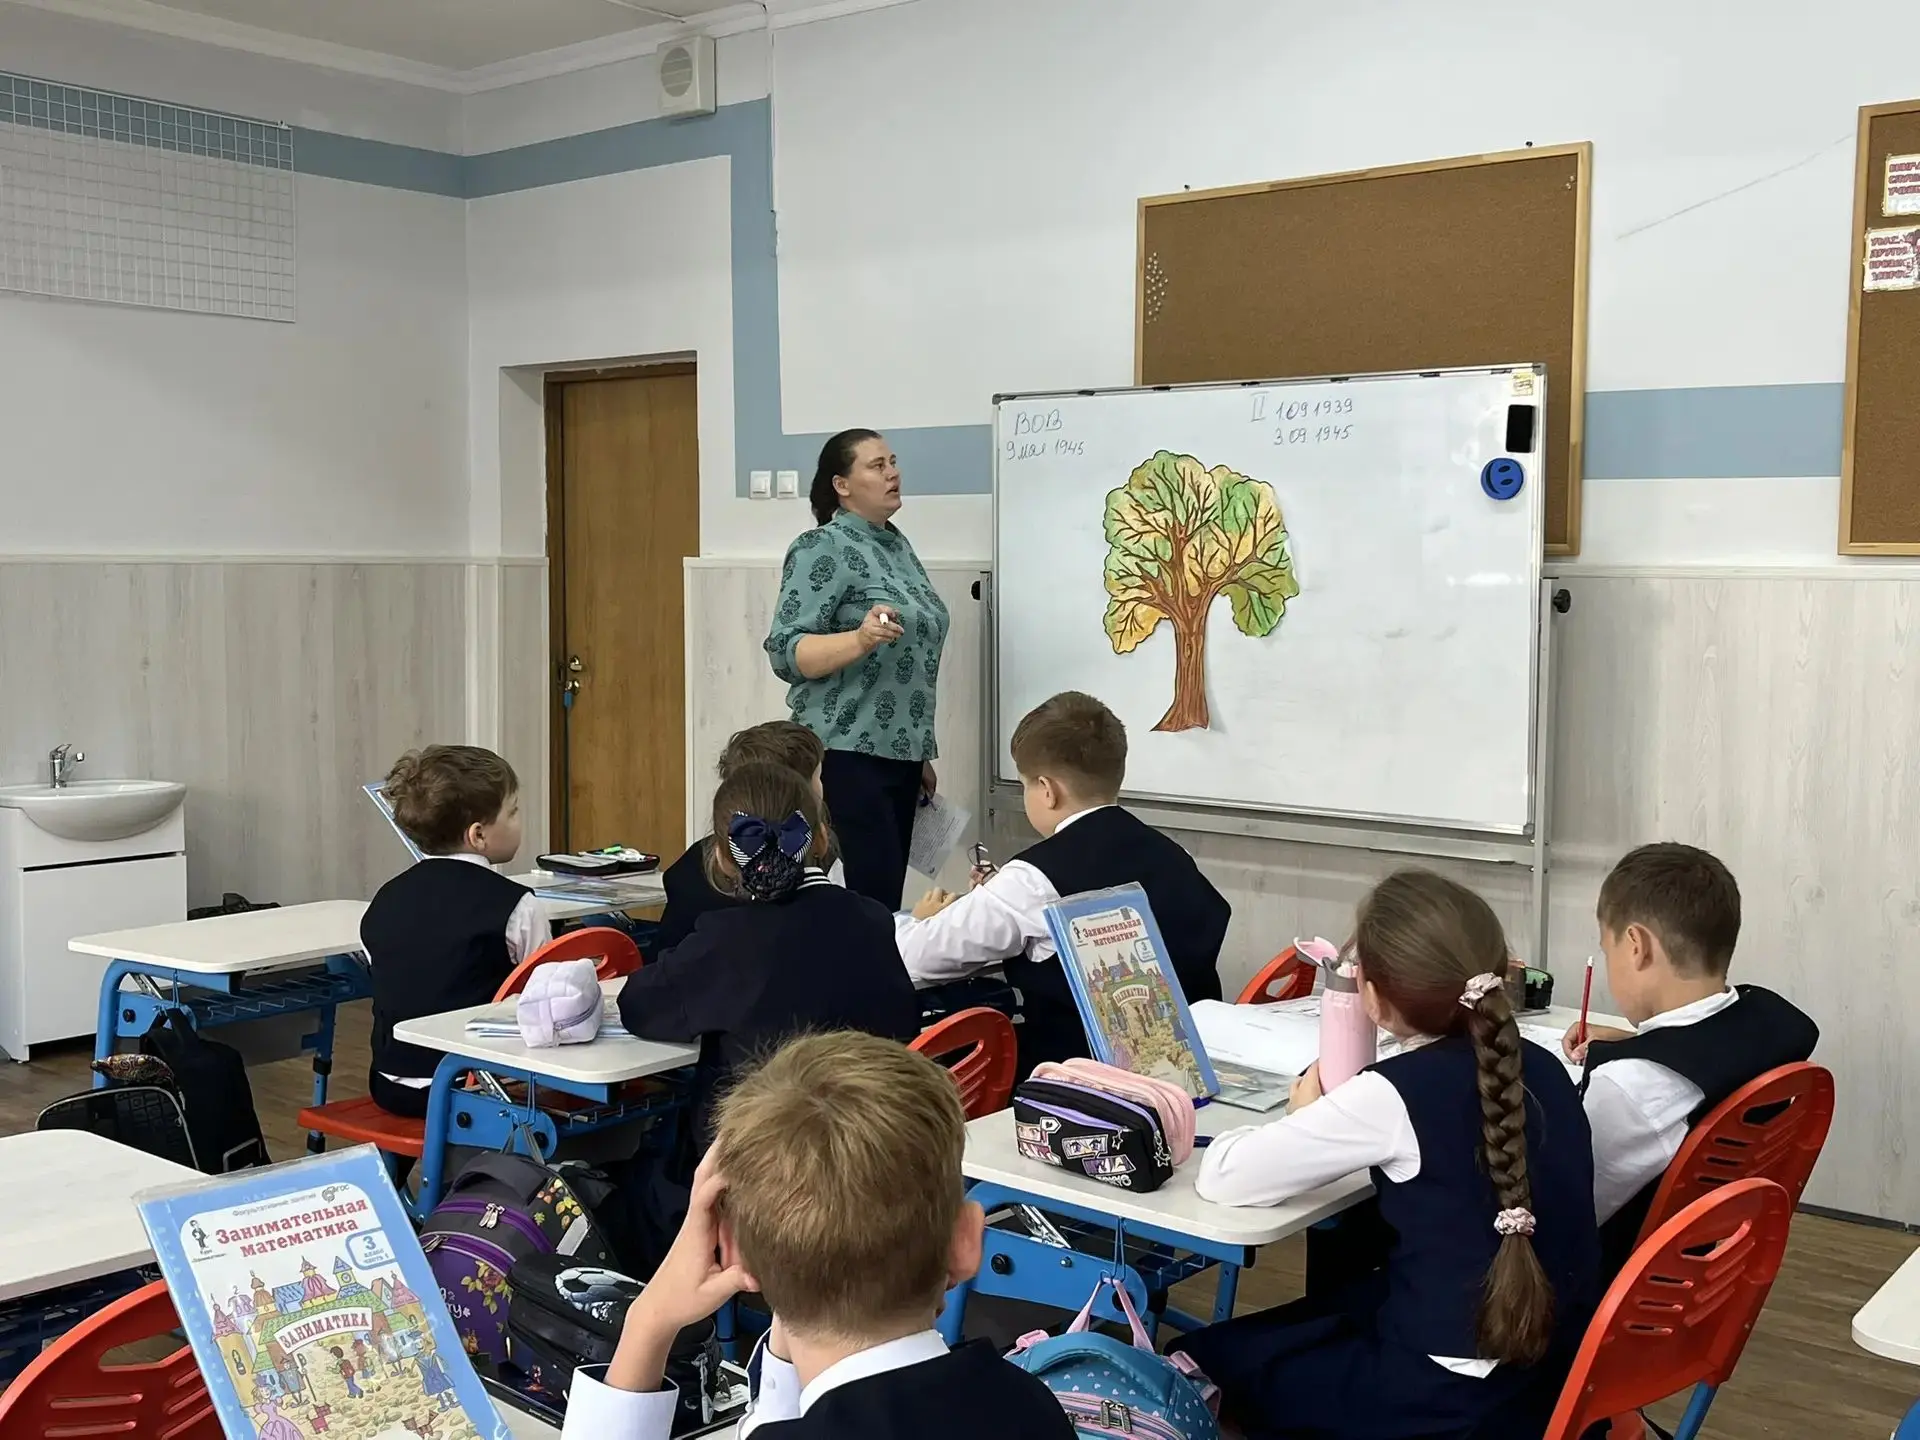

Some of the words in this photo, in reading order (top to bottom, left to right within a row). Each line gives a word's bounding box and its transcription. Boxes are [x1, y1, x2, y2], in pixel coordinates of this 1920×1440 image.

[1014, 409, 1063, 436] ВОВ
[1315, 424, 1354, 443] 1945
[1055, 439, 1084, 456] 1945
[1082, 918, 1142, 938] Занимательная
[1093, 930, 1139, 947] математика
[215, 1199, 368, 1244] Занимательная
[240, 1219, 359, 1258] математика
[363, 1235, 377, 1250] 3
[279, 1312, 370, 1349] ЗАНИМАТИКА
